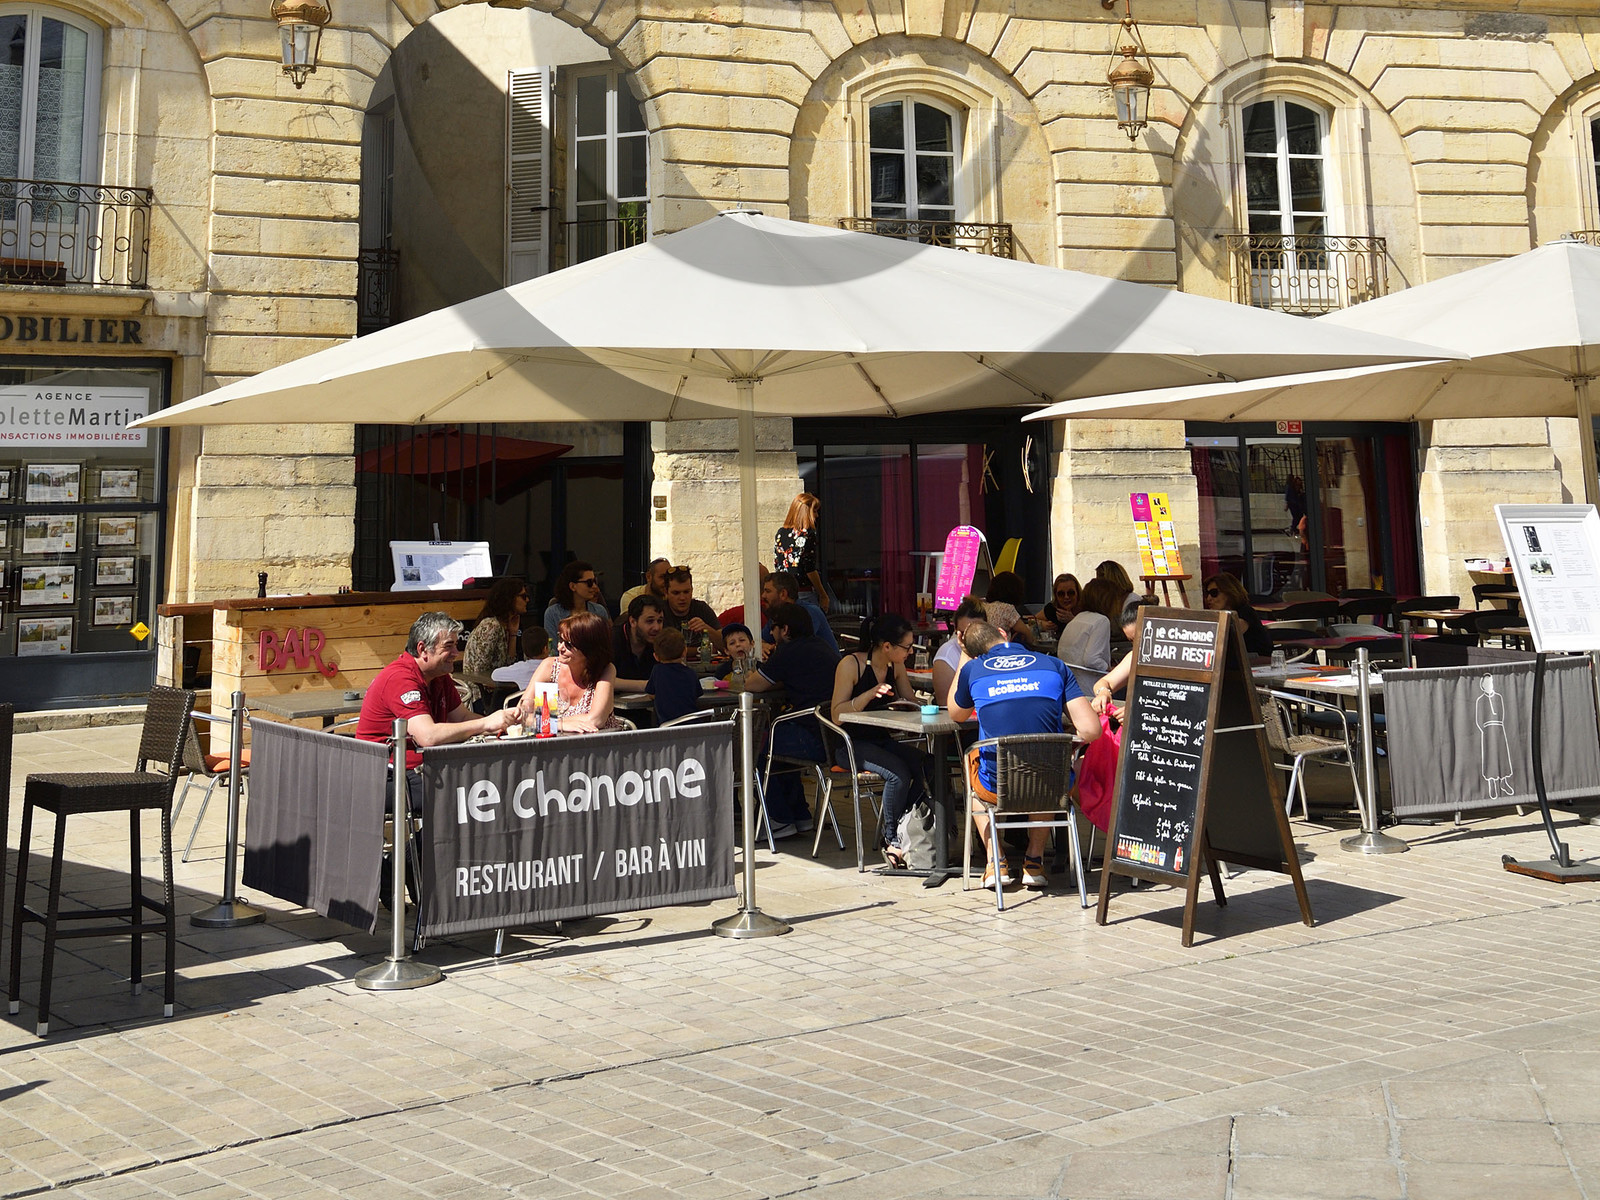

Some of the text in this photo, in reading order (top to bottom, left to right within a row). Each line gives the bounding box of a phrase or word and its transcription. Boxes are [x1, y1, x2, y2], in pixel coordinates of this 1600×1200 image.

[35, 392, 92, 401] AGENCE
[66, 432, 141, 441] IMMOBILIÈRES
[259, 628, 338, 677] BAR
[1153, 644, 1177, 660] BAR
[993, 655, 1026, 668] Ford
[988, 681, 1040, 697] EcoBoost
[455, 853, 583, 898] RESTAURANT
[615, 845, 653, 878] BAR
[658, 837, 671, 872] À
[675, 838, 706, 869] VIN
